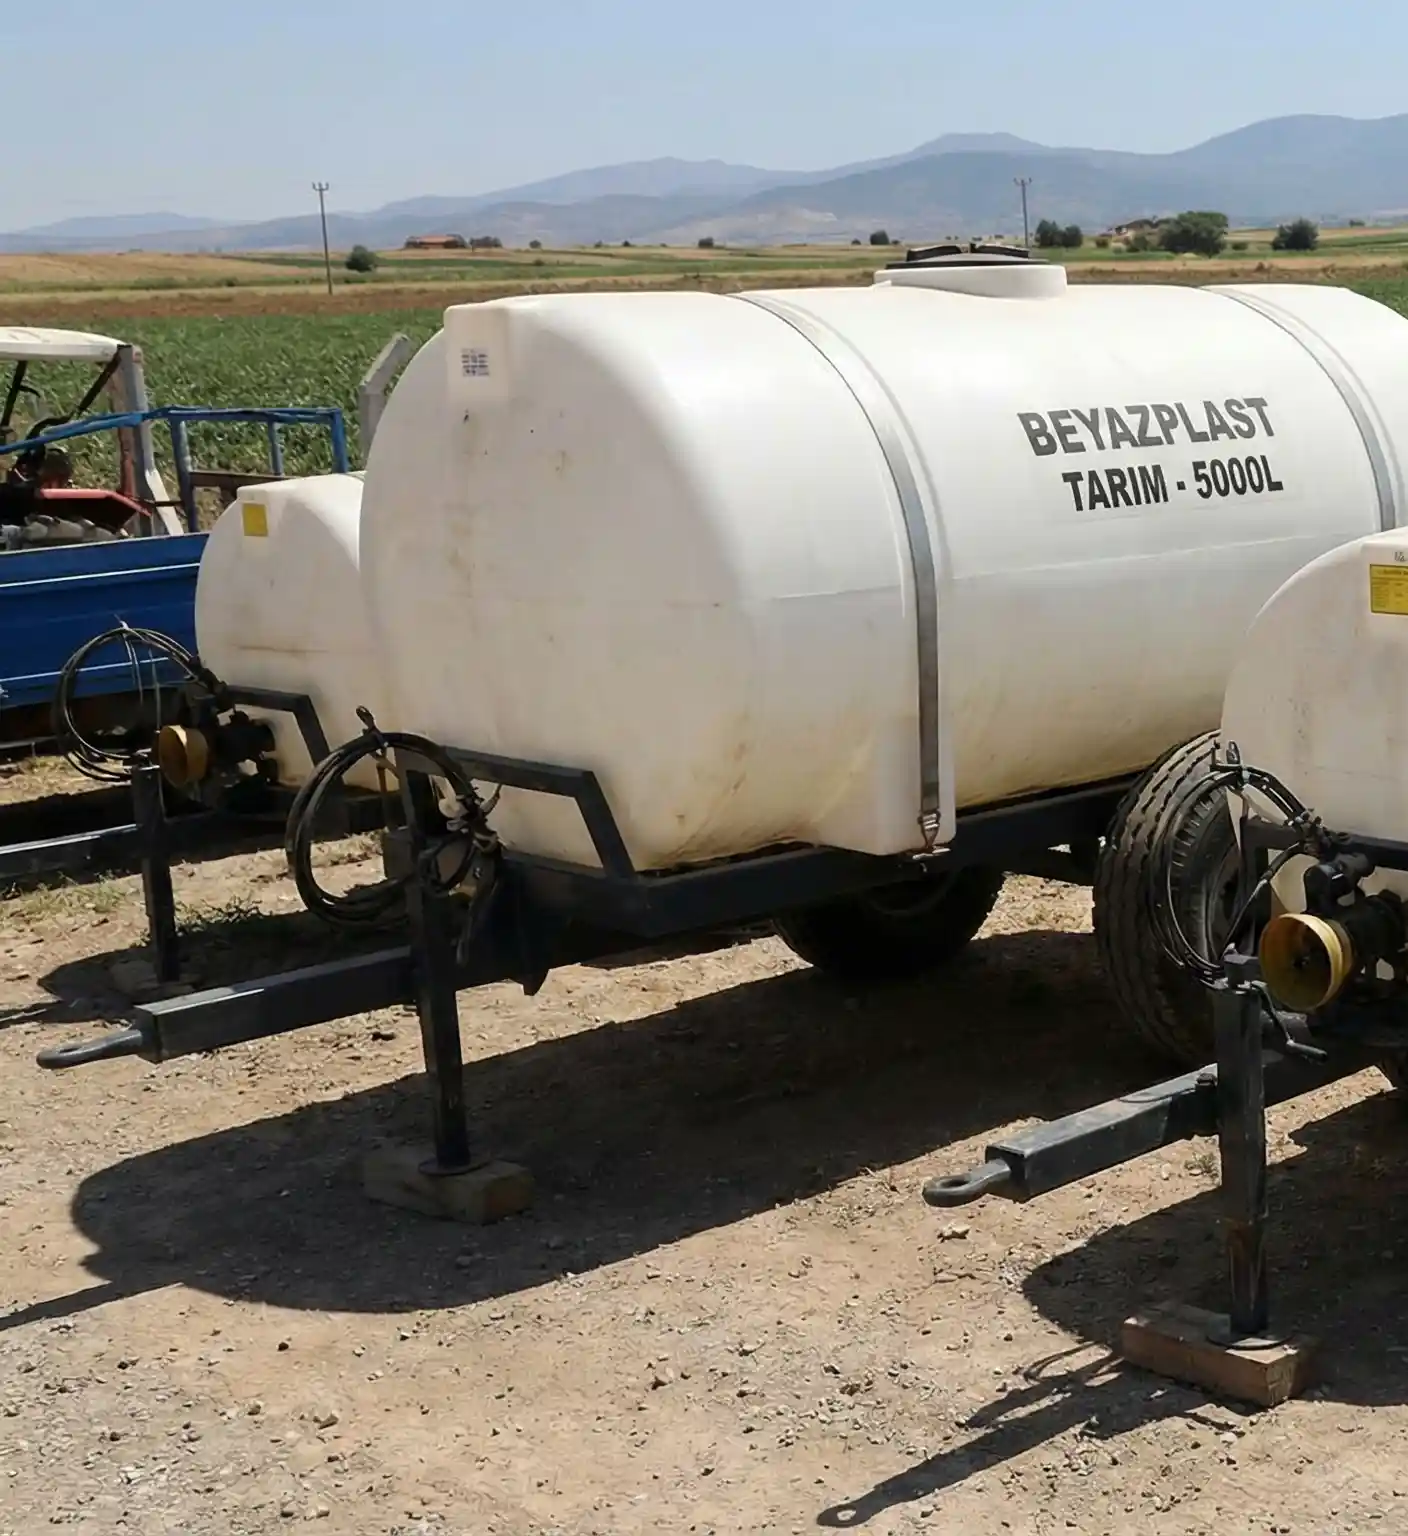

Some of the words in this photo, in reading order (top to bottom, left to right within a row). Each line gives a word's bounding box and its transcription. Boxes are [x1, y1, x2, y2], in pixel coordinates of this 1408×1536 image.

[1017, 398, 1274, 456] BEYAZPLAST
[1062, 465, 1169, 511] TARIM
[1192, 455, 1283, 499] 5000L
